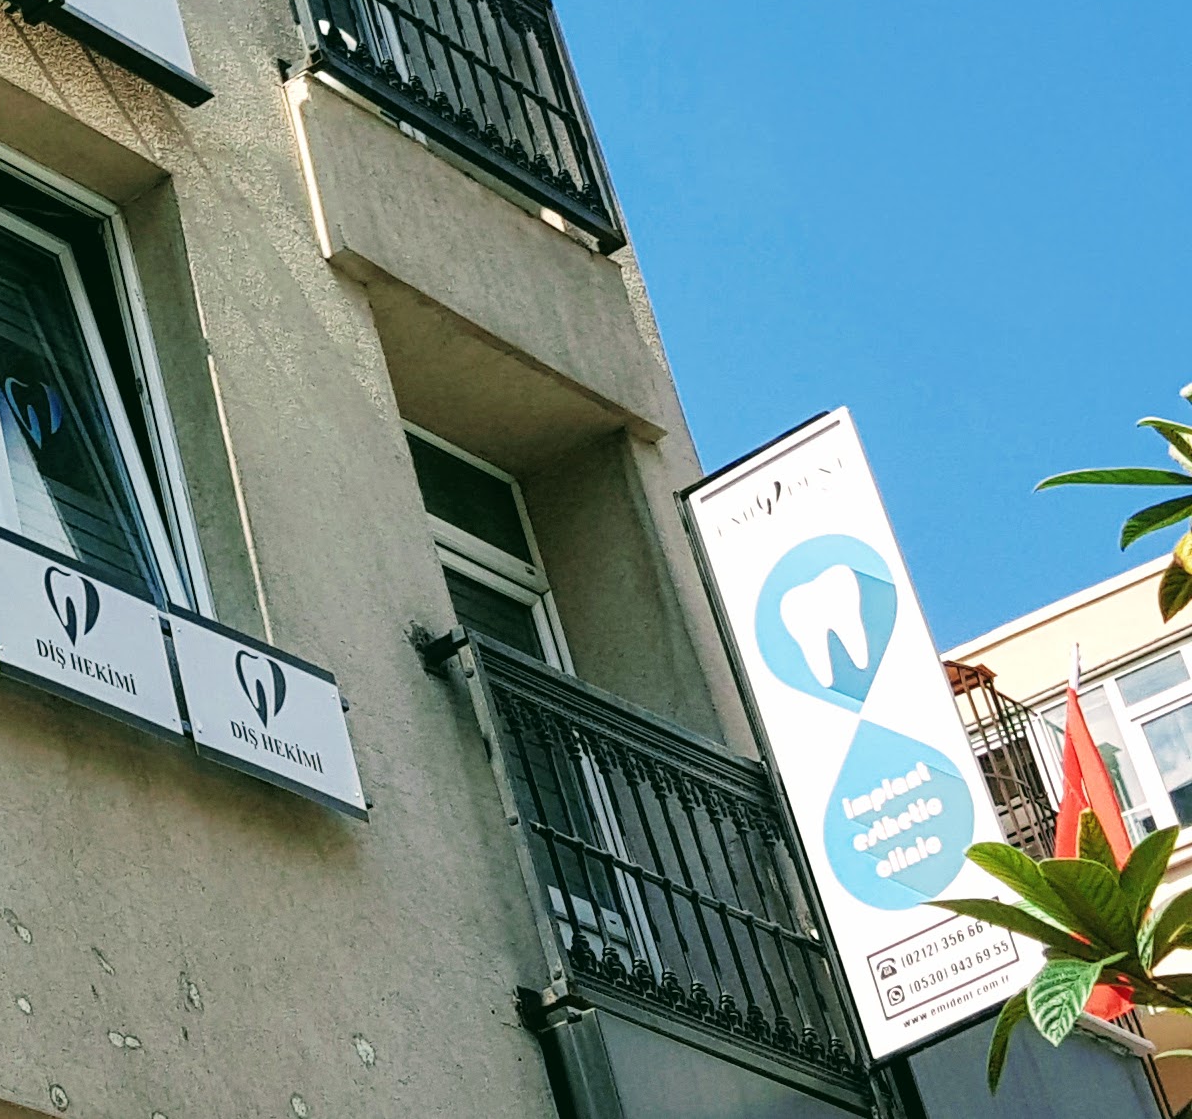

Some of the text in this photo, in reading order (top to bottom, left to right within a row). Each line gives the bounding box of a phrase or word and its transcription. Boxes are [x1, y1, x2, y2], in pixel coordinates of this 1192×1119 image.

[36, 638, 138, 697] DİŞ HEKİMİ
[230, 720, 324, 775] DİŞ HEKİMİ
[901, 942, 939, 968] (0212)
[941, 929, 965, 951] 356
[967, 920, 984, 937] 66
[909, 940, 1009, 994] (0530) 943 69 55
[903, 975, 1009, 1028] wwwemidentcomtr
